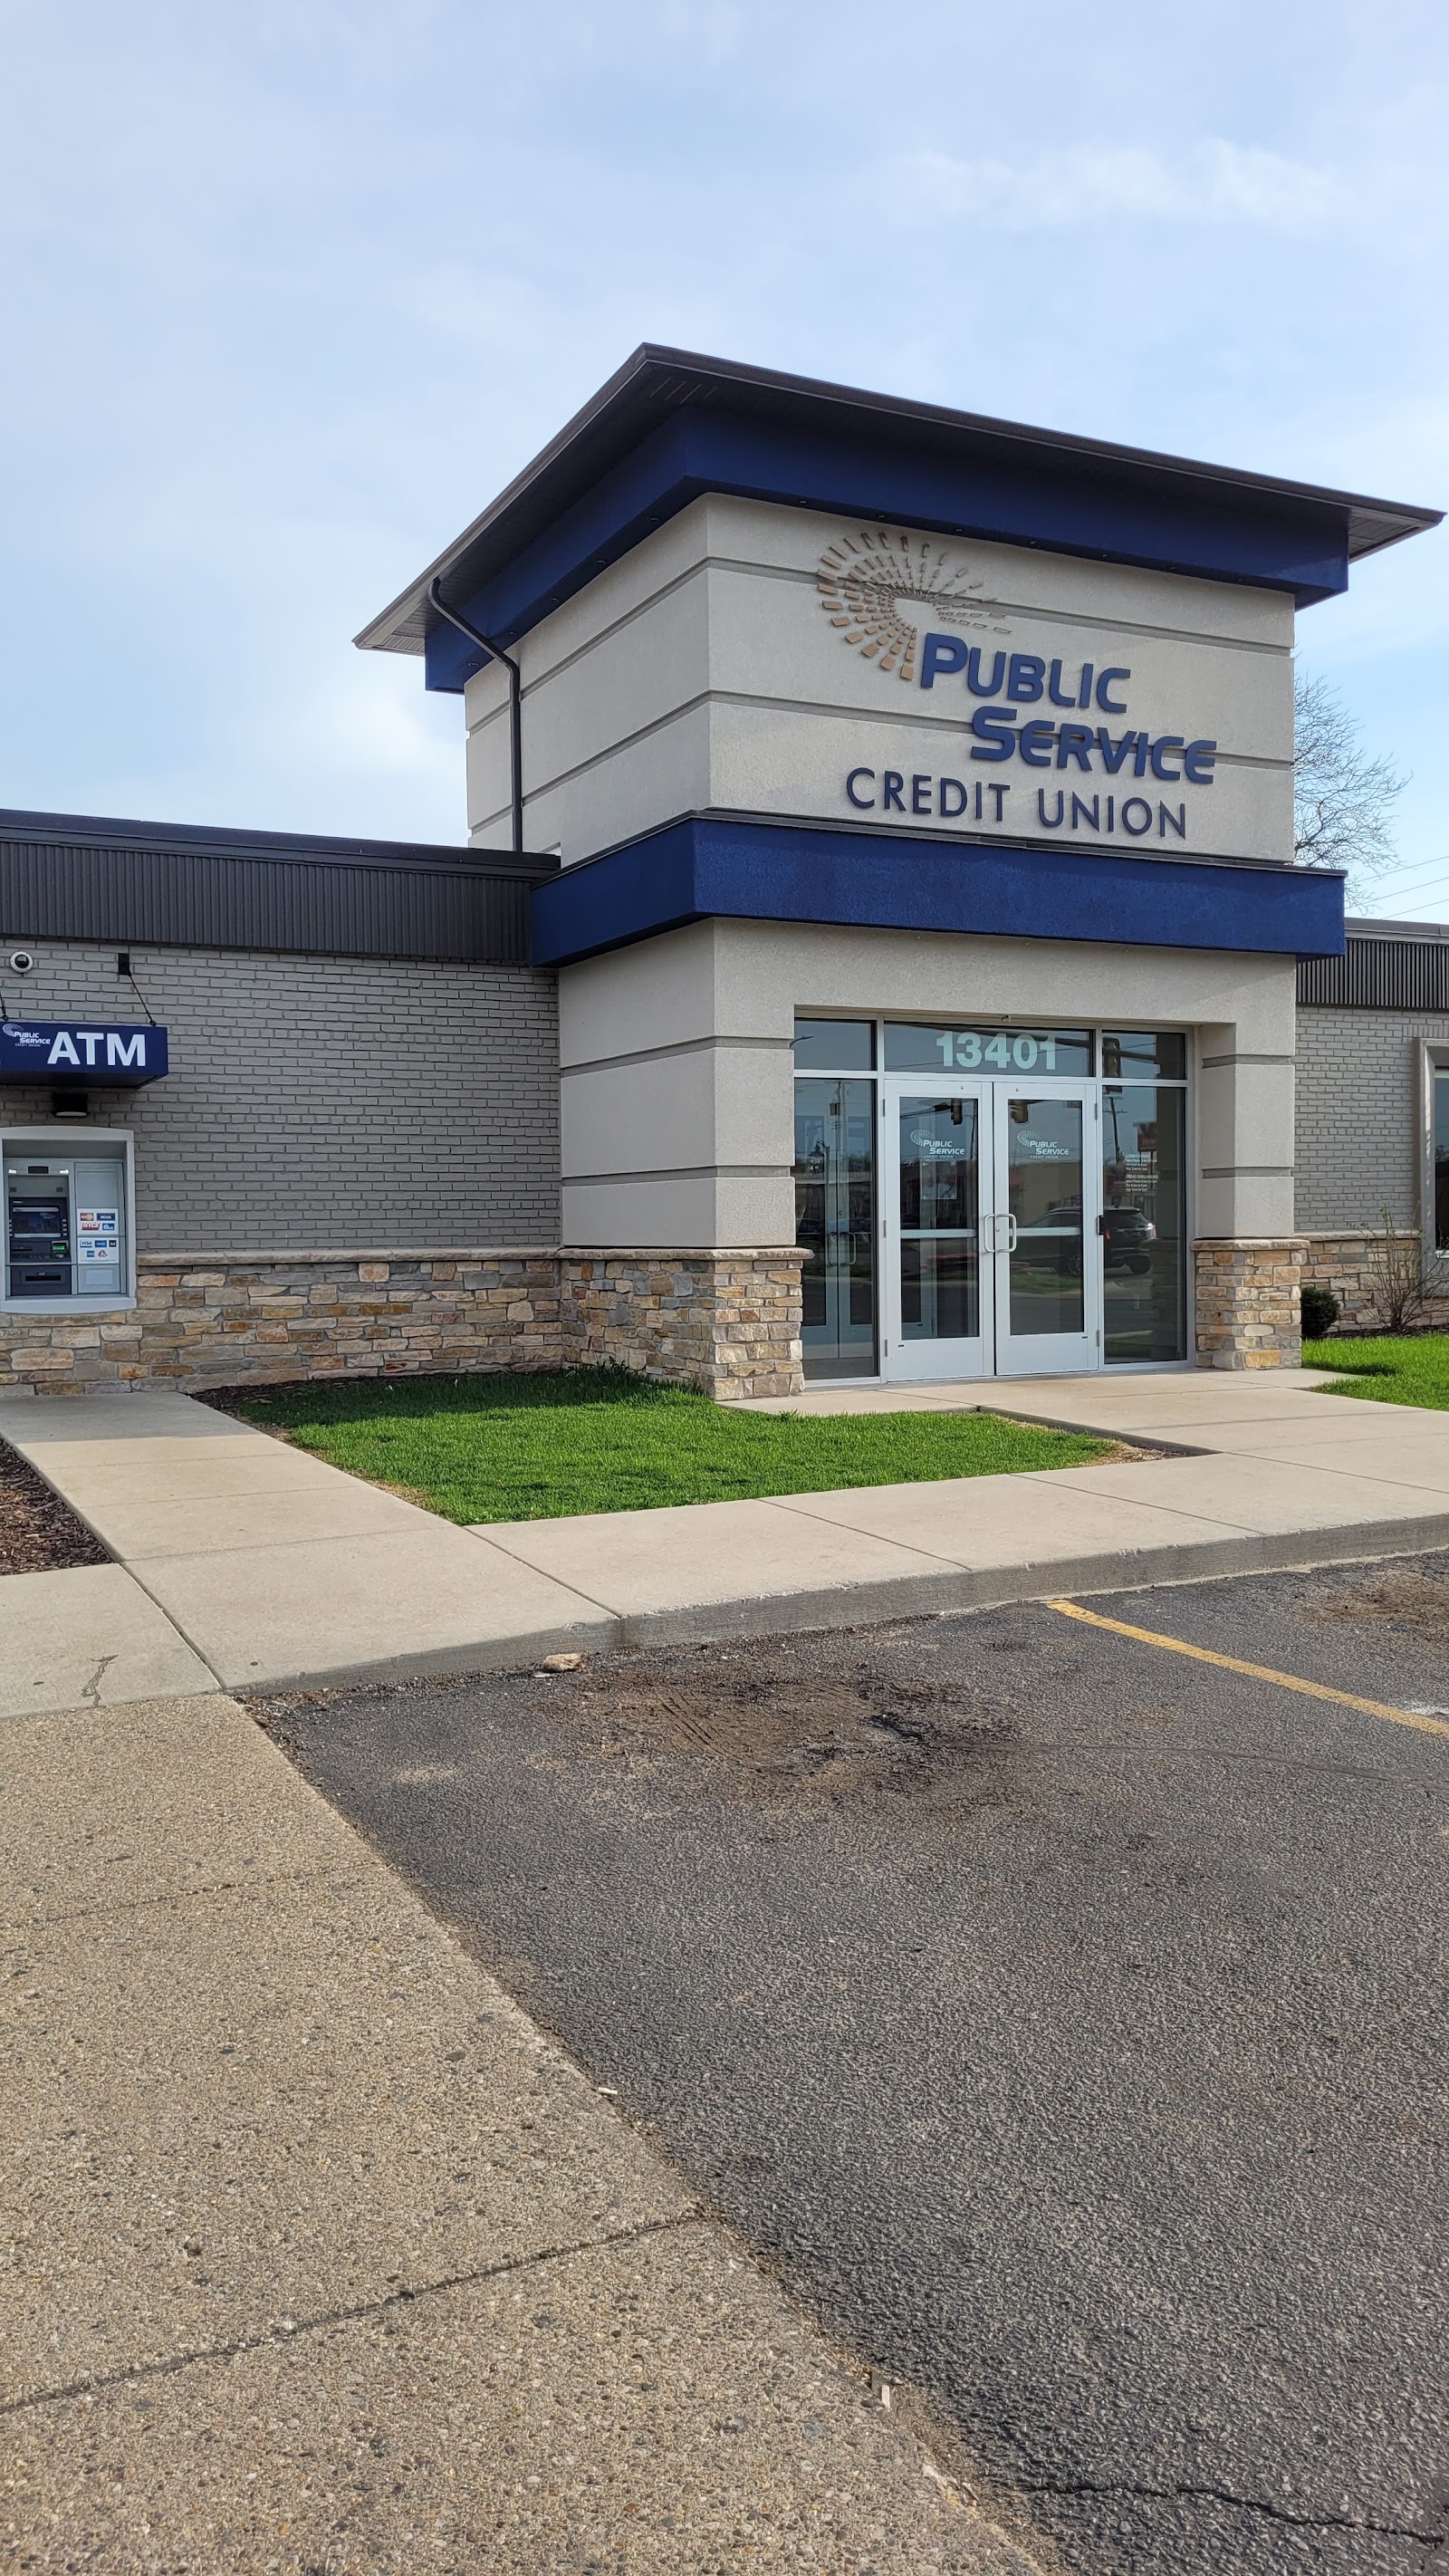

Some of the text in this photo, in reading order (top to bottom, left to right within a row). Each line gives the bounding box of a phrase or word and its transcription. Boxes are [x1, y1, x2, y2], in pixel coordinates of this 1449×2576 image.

[920, 632, 1131, 714] PUBLIC
[970, 706, 1217, 784] SERVICE
[846, 767, 1186, 841] CREDIT UNION
[47, 1032, 146, 1066] ATM
[936, 1031, 1056, 1070] 13401
[923, 1139, 953, 1148] PUBLIC
[928, 1147, 965, 1155] SERVICE
